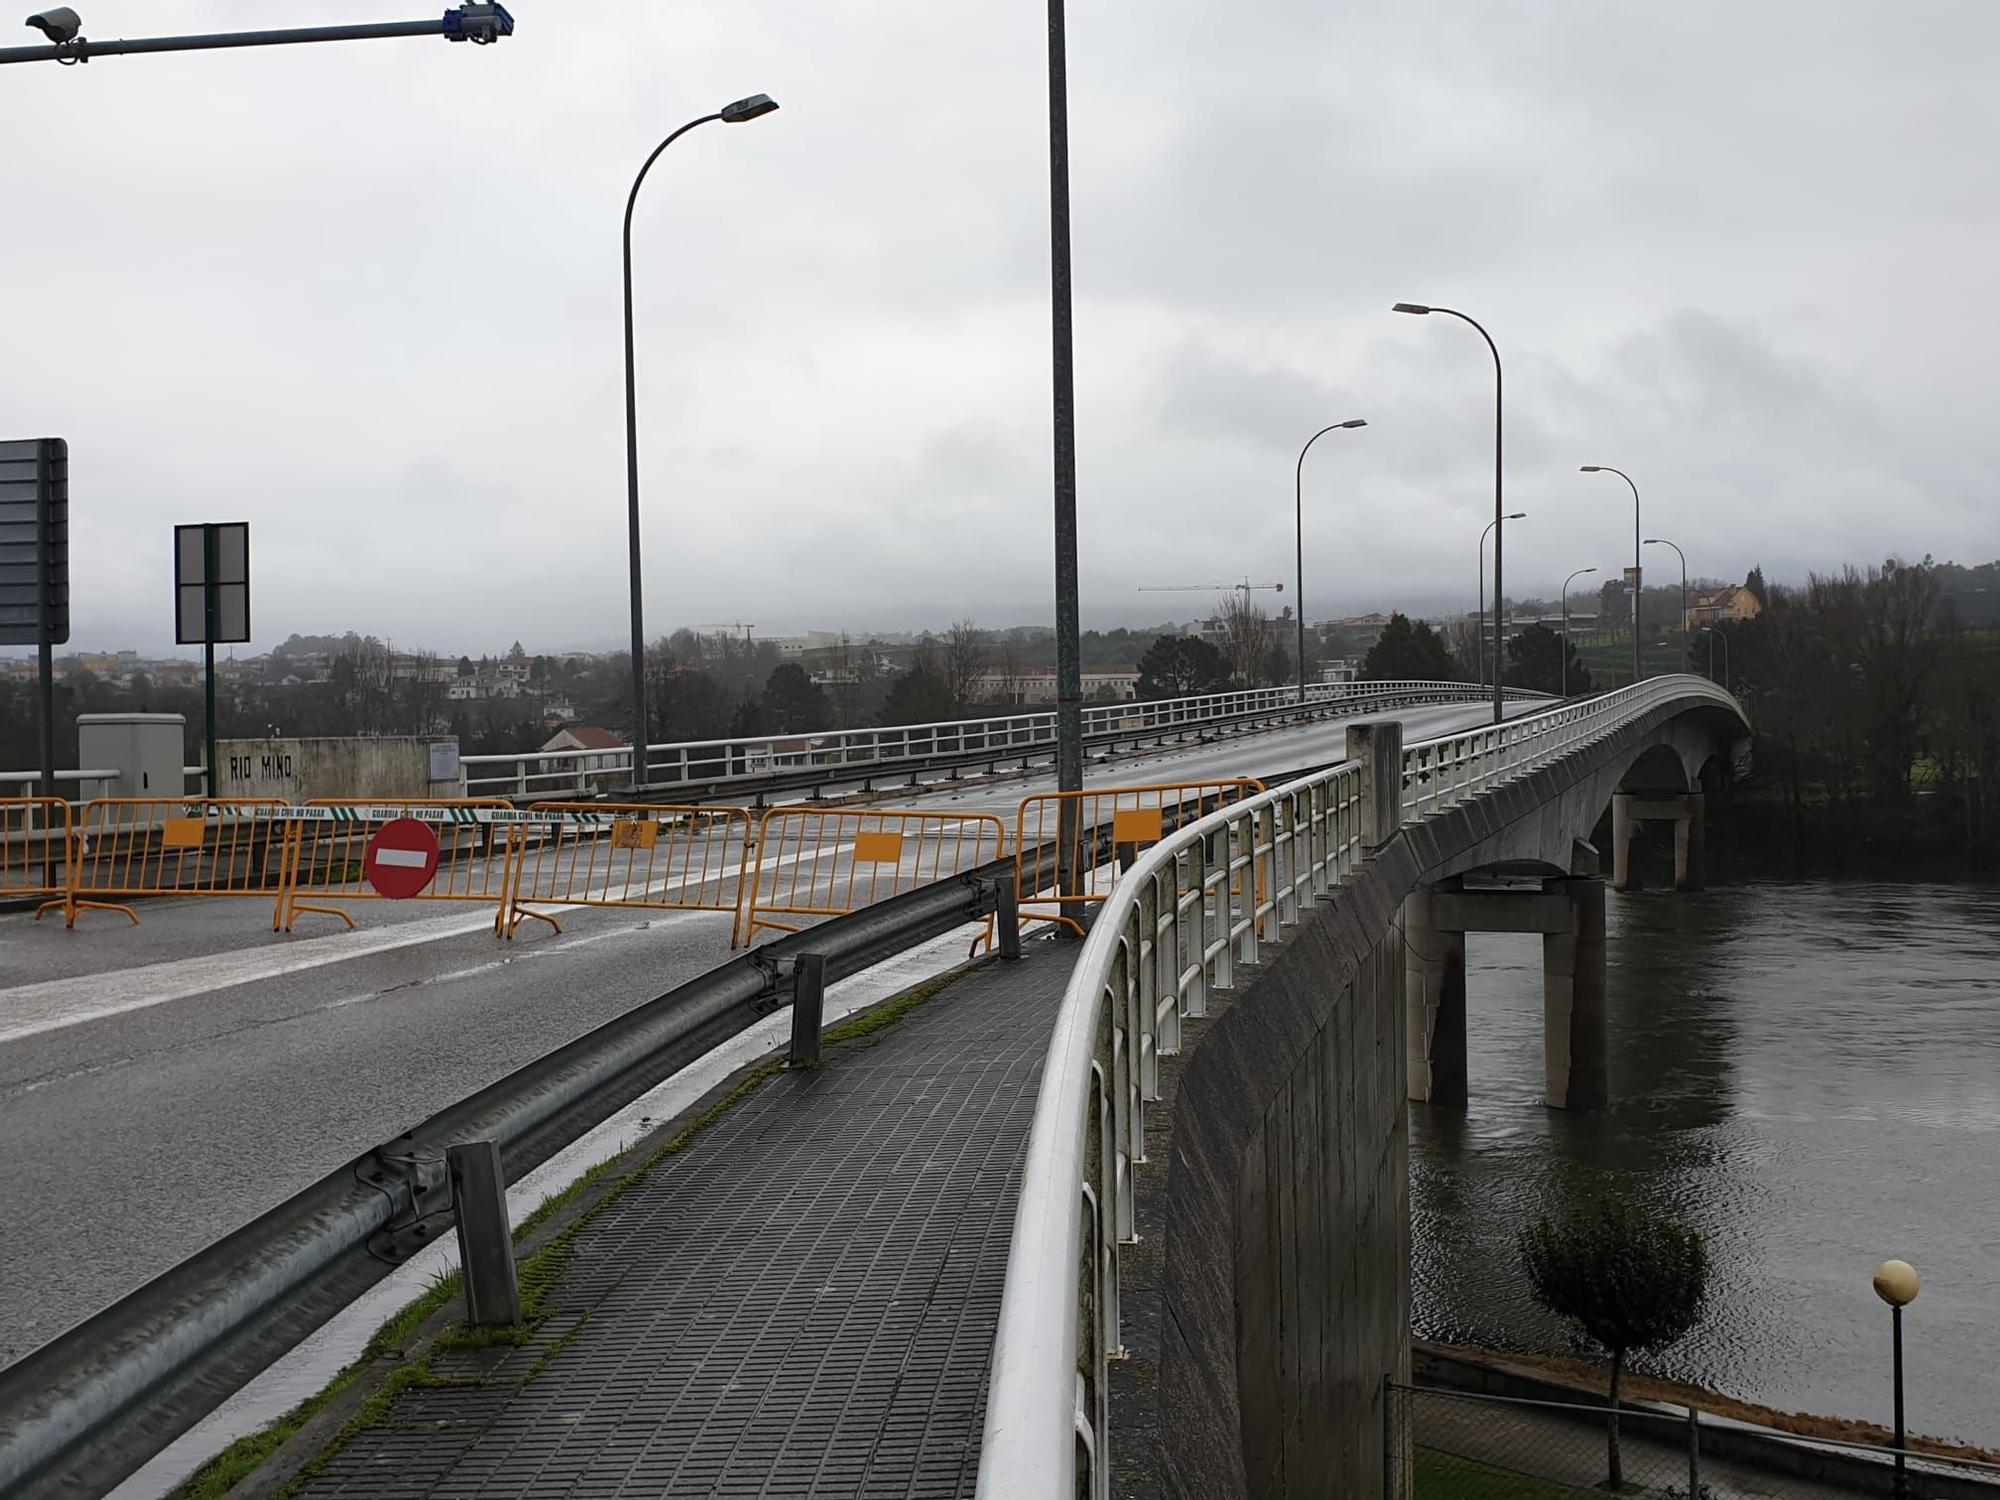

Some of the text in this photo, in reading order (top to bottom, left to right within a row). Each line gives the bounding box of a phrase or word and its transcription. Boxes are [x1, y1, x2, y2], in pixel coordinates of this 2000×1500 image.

[230, 756, 251, 779] RIO
[296, 809, 304, 818] NO
[305, 809, 325, 818] PASAR
[372, 809, 398, 818] GUARDIA
[415, 811, 424, 819] NO
[424, 810, 444, 819] PASAR
